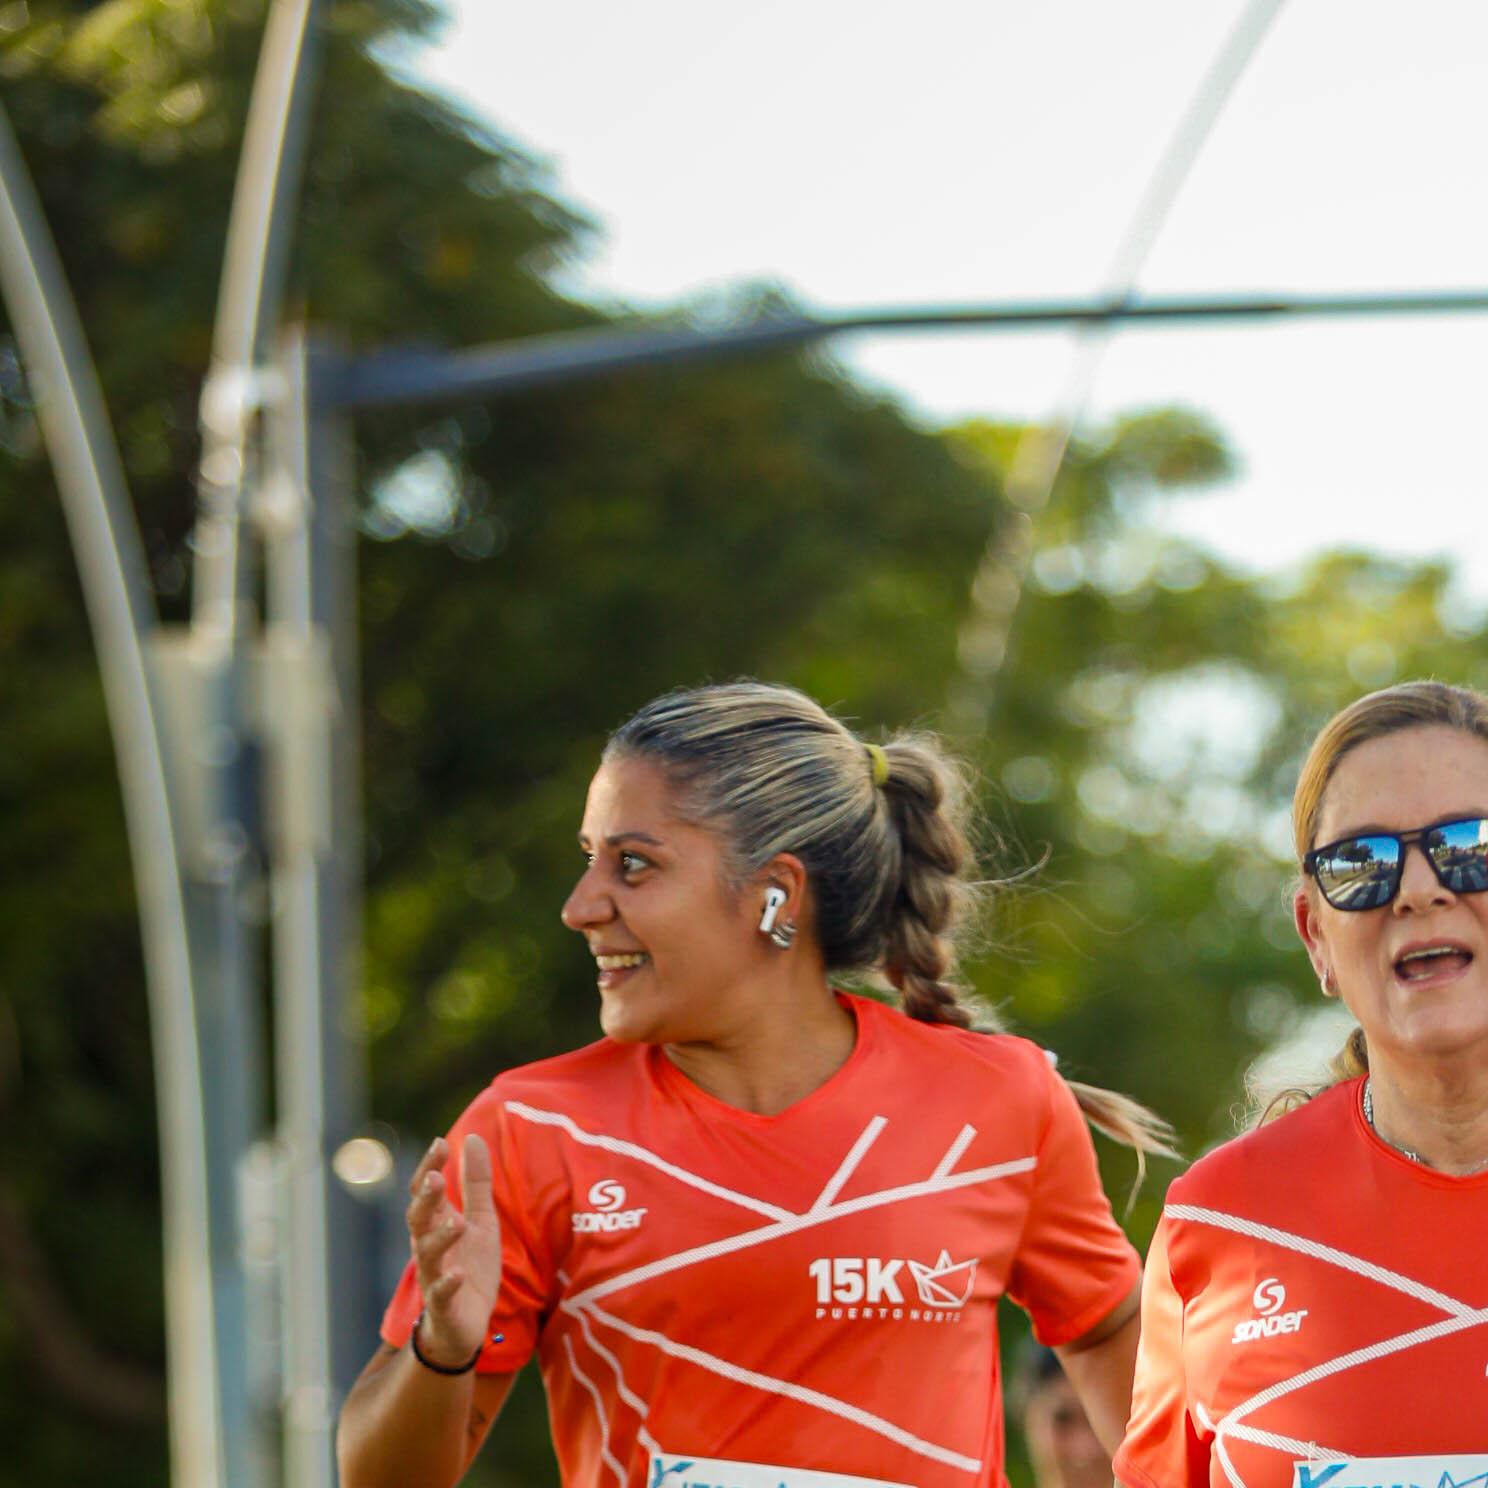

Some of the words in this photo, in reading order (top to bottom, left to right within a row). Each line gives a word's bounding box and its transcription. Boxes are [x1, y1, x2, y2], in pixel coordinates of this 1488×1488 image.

[808, 1257, 905, 1304] 15K
[815, 1308, 904, 1320] PUERTO
[909, 1310, 961, 1322] NORTE
